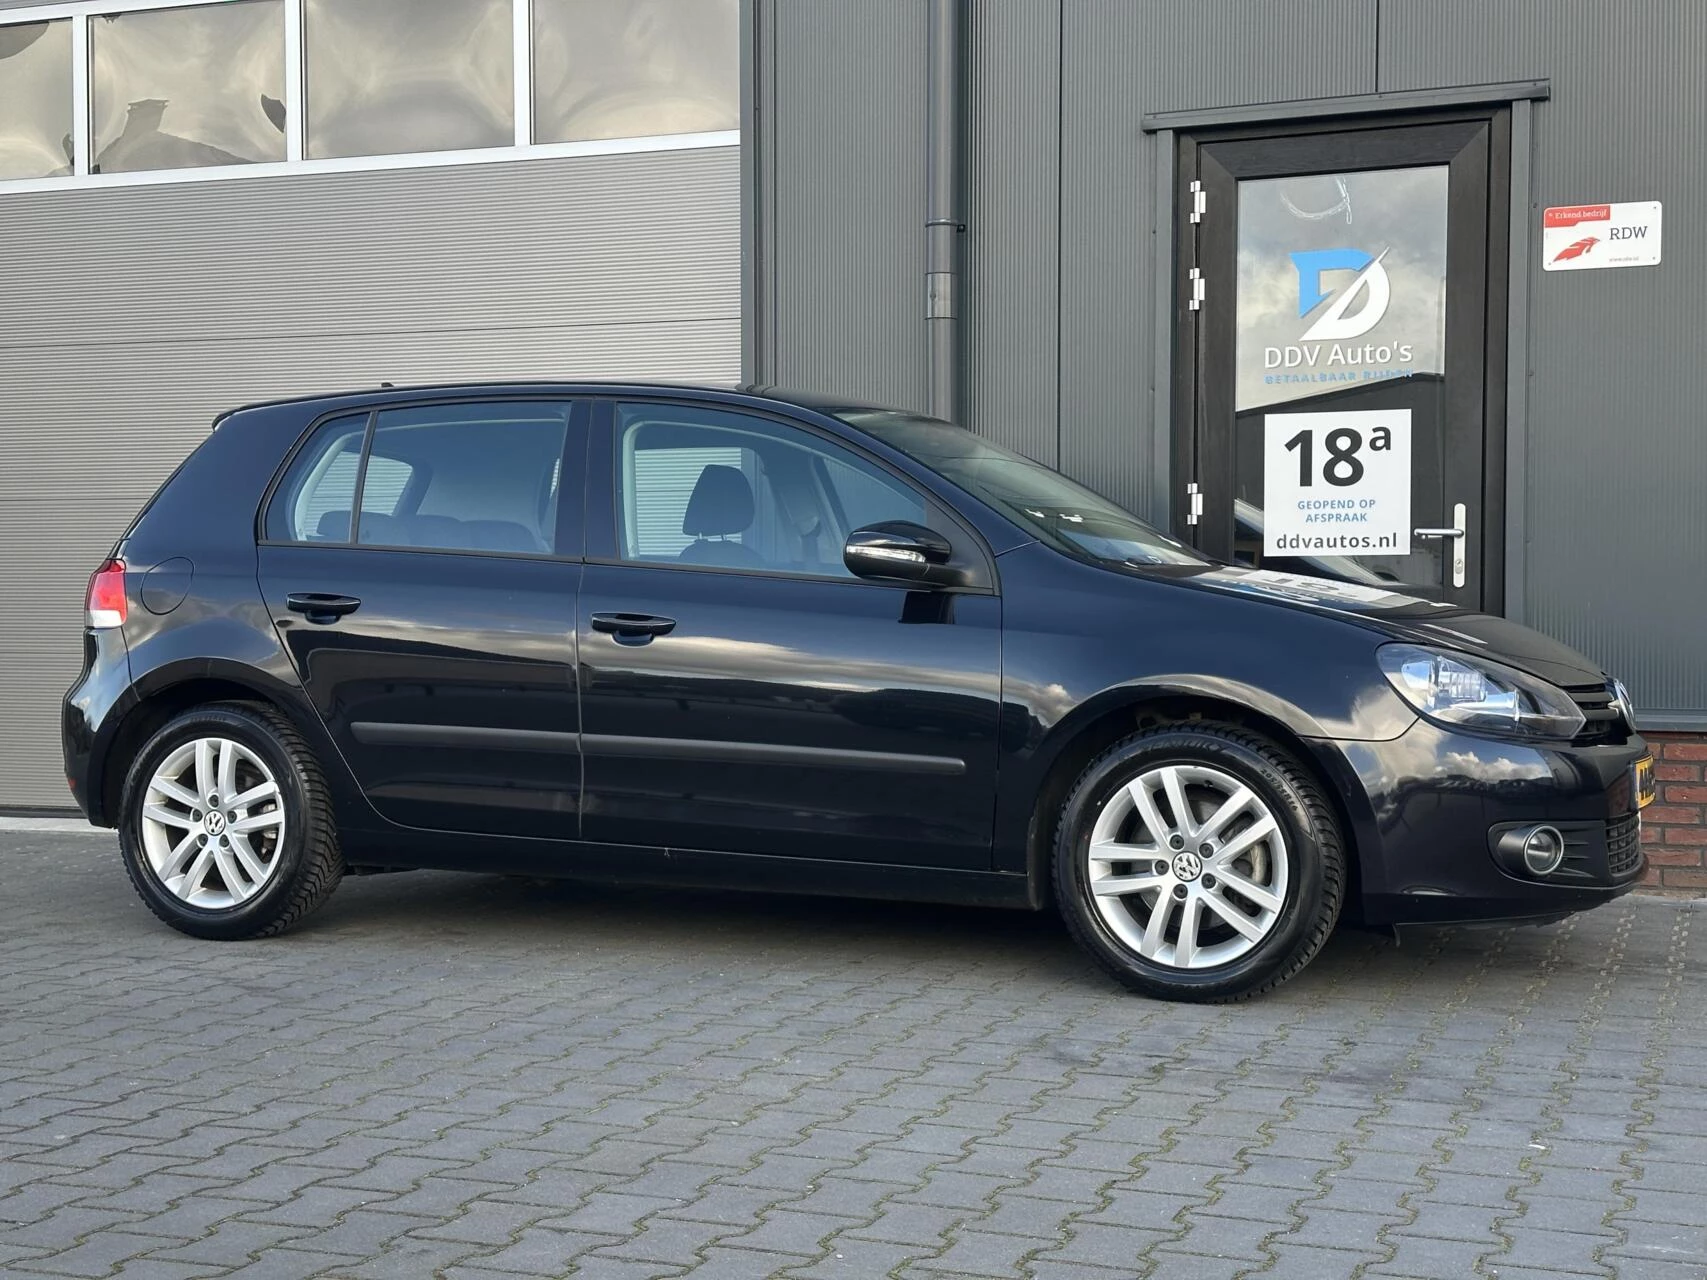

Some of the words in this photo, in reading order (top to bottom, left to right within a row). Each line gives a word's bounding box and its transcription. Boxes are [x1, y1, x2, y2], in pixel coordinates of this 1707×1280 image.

[1609, 226, 1648, 240] RDW
[1264, 345, 1321, 369] DDV
[1327, 341, 1413, 365] Auto's
[1297, 500, 1355, 510] GEOPEND
[1359, 499, 1376, 509] OP
[1305, 513, 1368, 523] AFSPRAAK
[1276, 532, 1397, 549] ddvautos.nl
